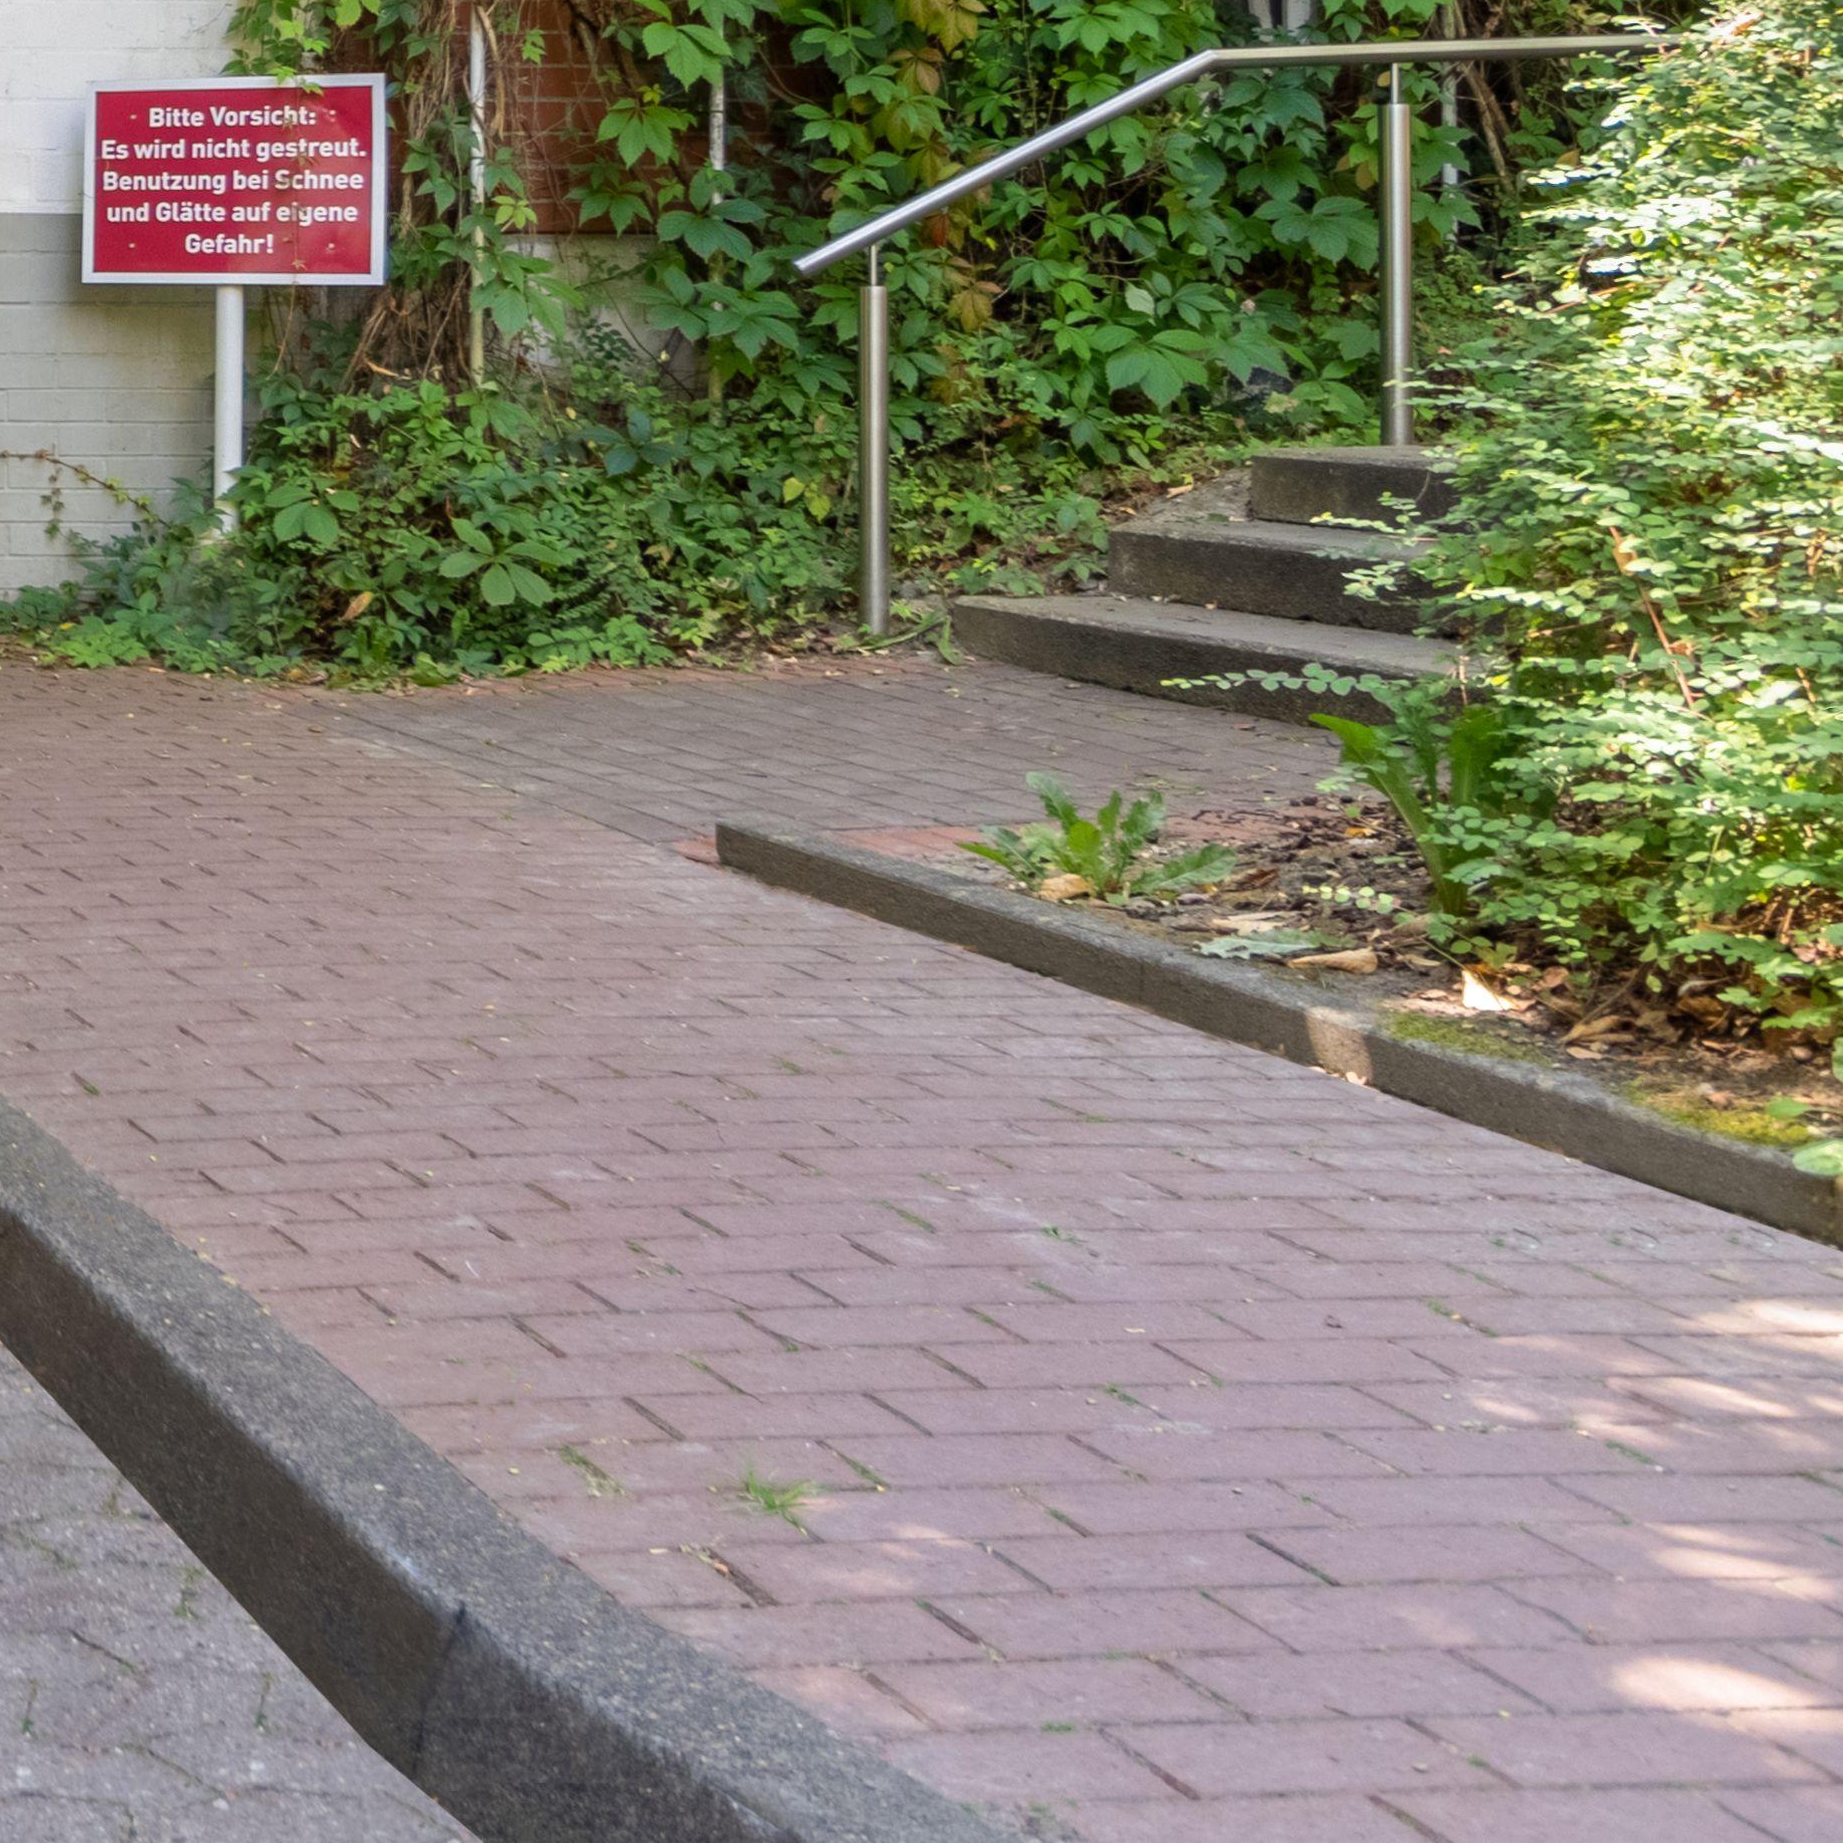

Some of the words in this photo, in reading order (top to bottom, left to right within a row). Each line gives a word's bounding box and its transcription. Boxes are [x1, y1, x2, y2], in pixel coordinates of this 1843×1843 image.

[149, 107, 204, 127] Bitte
[210, 106, 316, 126] Vorsicht:
[101, 140, 128, 159] Es
[134, 140, 185, 158] wird
[192, 139, 250, 158] nicht
[256, 138, 366, 162] gestreut.
[103, 171, 226, 194] Benutzung
[232, 170, 269, 189] bei
[275, 170, 364, 189] Schnee
[107, 202, 149, 222] und
[156, 203, 225, 222] Glätte
[232, 202, 271, 222] auf
[276, 202, 358, 226] eigene
[185, 234, 274, 254] Gefahr!
